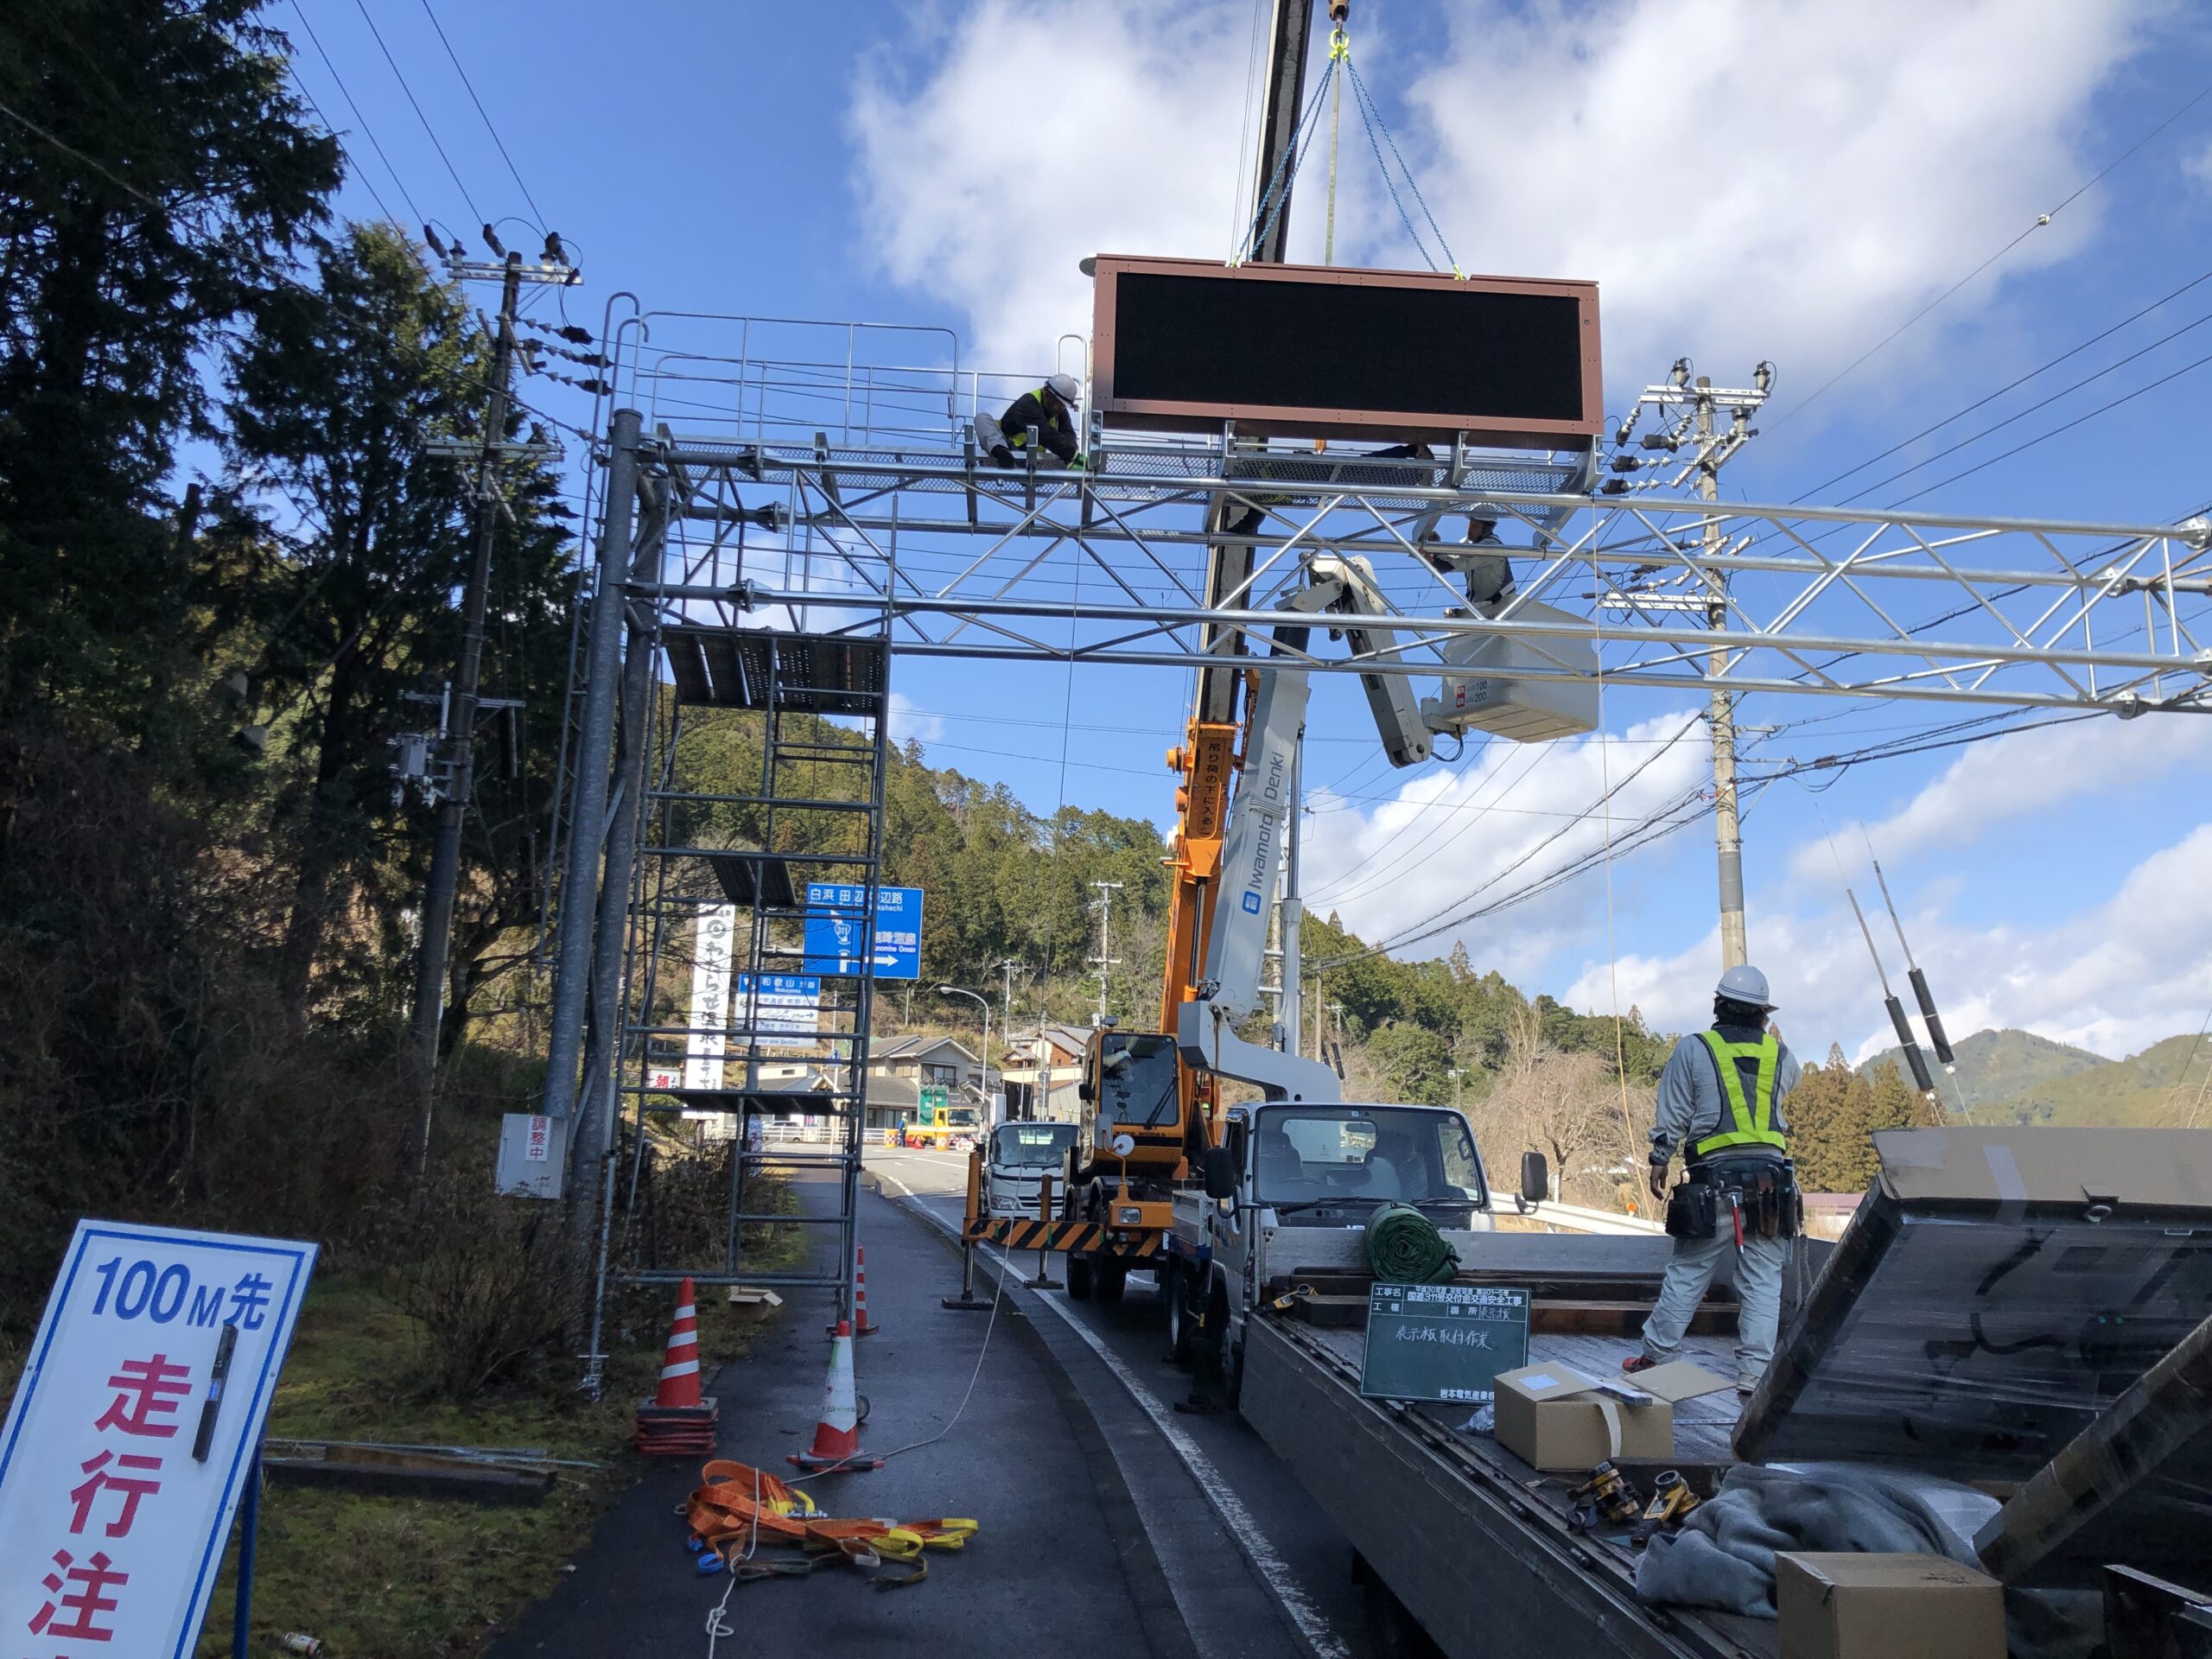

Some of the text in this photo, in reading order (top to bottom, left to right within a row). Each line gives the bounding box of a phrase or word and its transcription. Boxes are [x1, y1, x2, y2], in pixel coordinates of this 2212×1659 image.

[1475, 691, 1486, 702] 200
[1248, 752, 1285, 889] Iwamoto Denki
[810, 888, 835, 901] 白浜
[836, 927, 848, 936] 311
[530, 1117, 547, 1160] 調整中
[91, 1256, 273, 1332] 100M先
[1375, 1287, 1401, 1297] 工事名
[22, 1353, 193, 1659] 走行注
